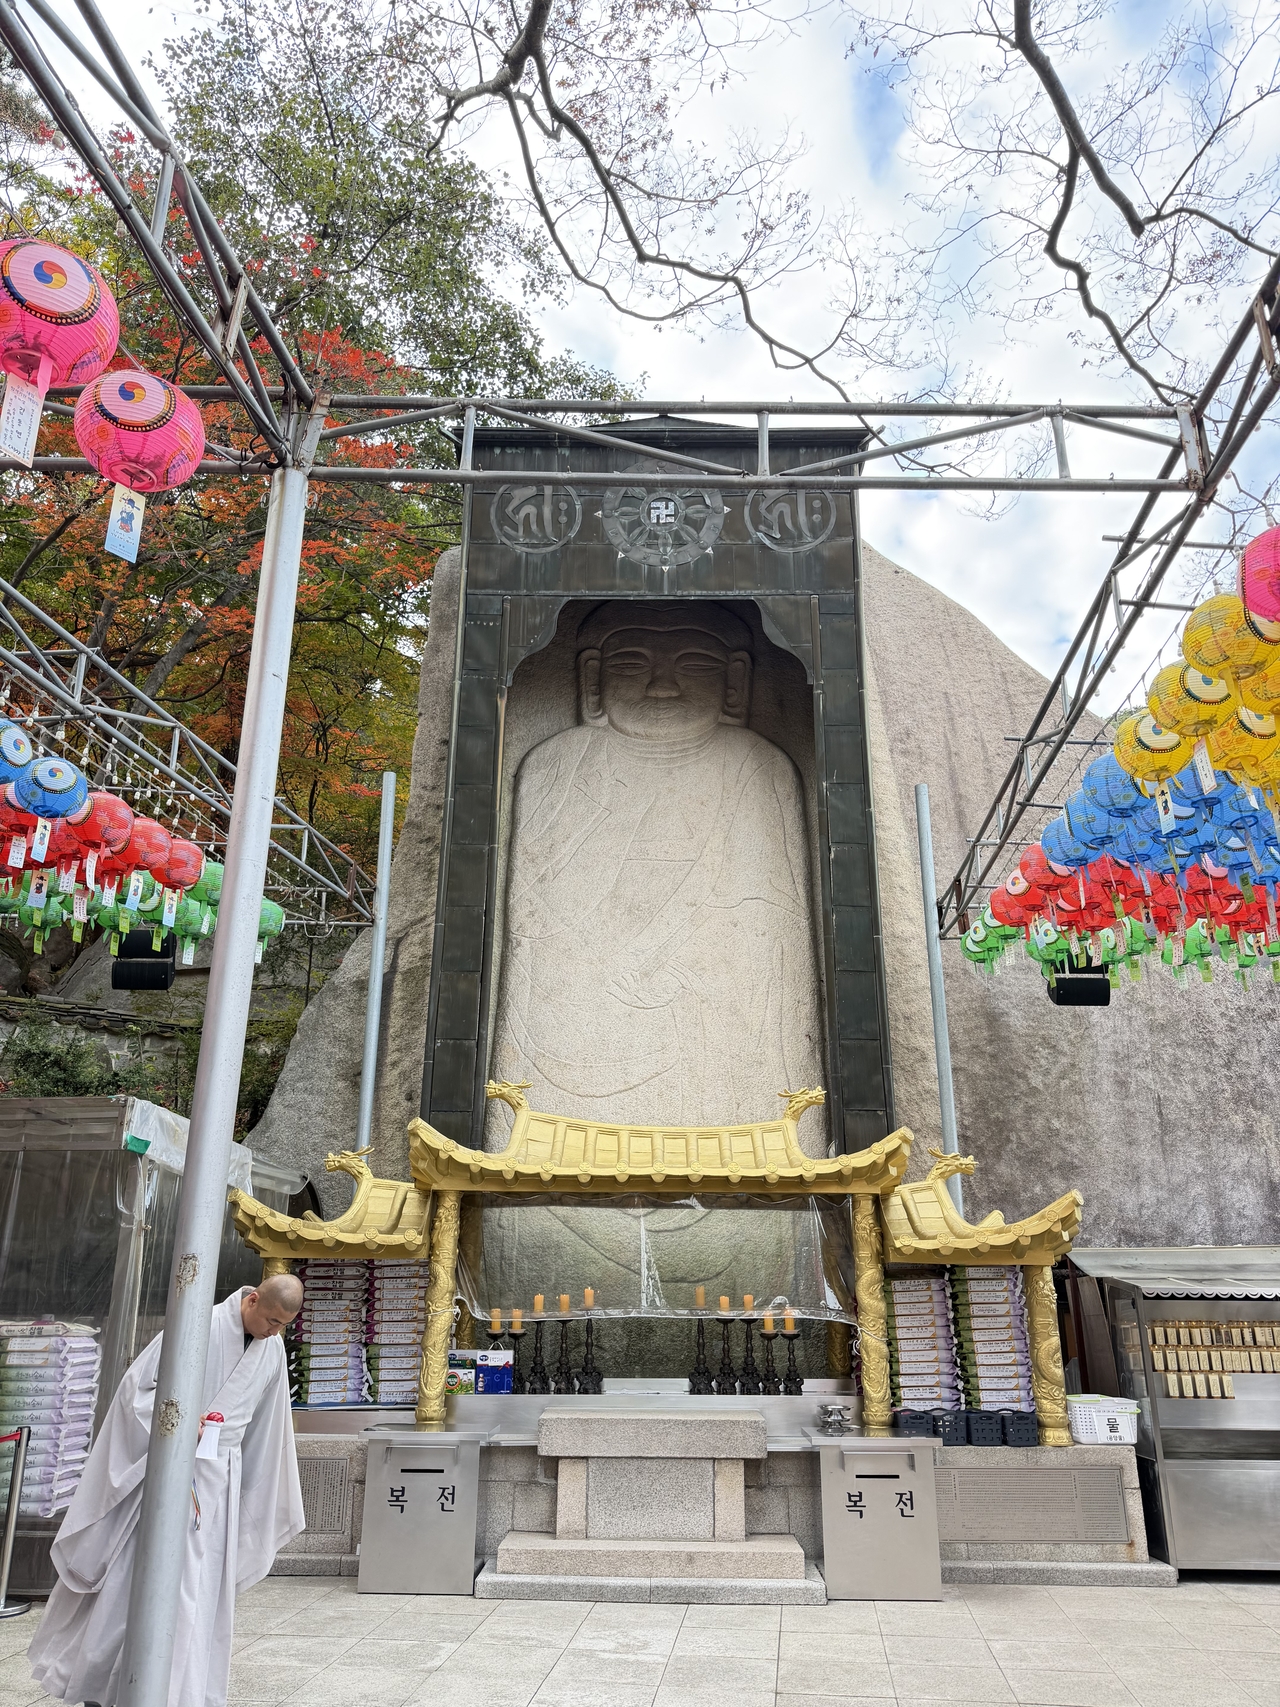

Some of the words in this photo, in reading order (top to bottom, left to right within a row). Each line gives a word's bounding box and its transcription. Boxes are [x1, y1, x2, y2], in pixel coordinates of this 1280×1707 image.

[1106, 1417, 1120, 1434] 물
[387, 1486, 408, 1514] 복
[436, 1485, 456, 1513] 전
[845, 1491, 866, 1519] 복
[894, 1490, 915, 1518] 전
